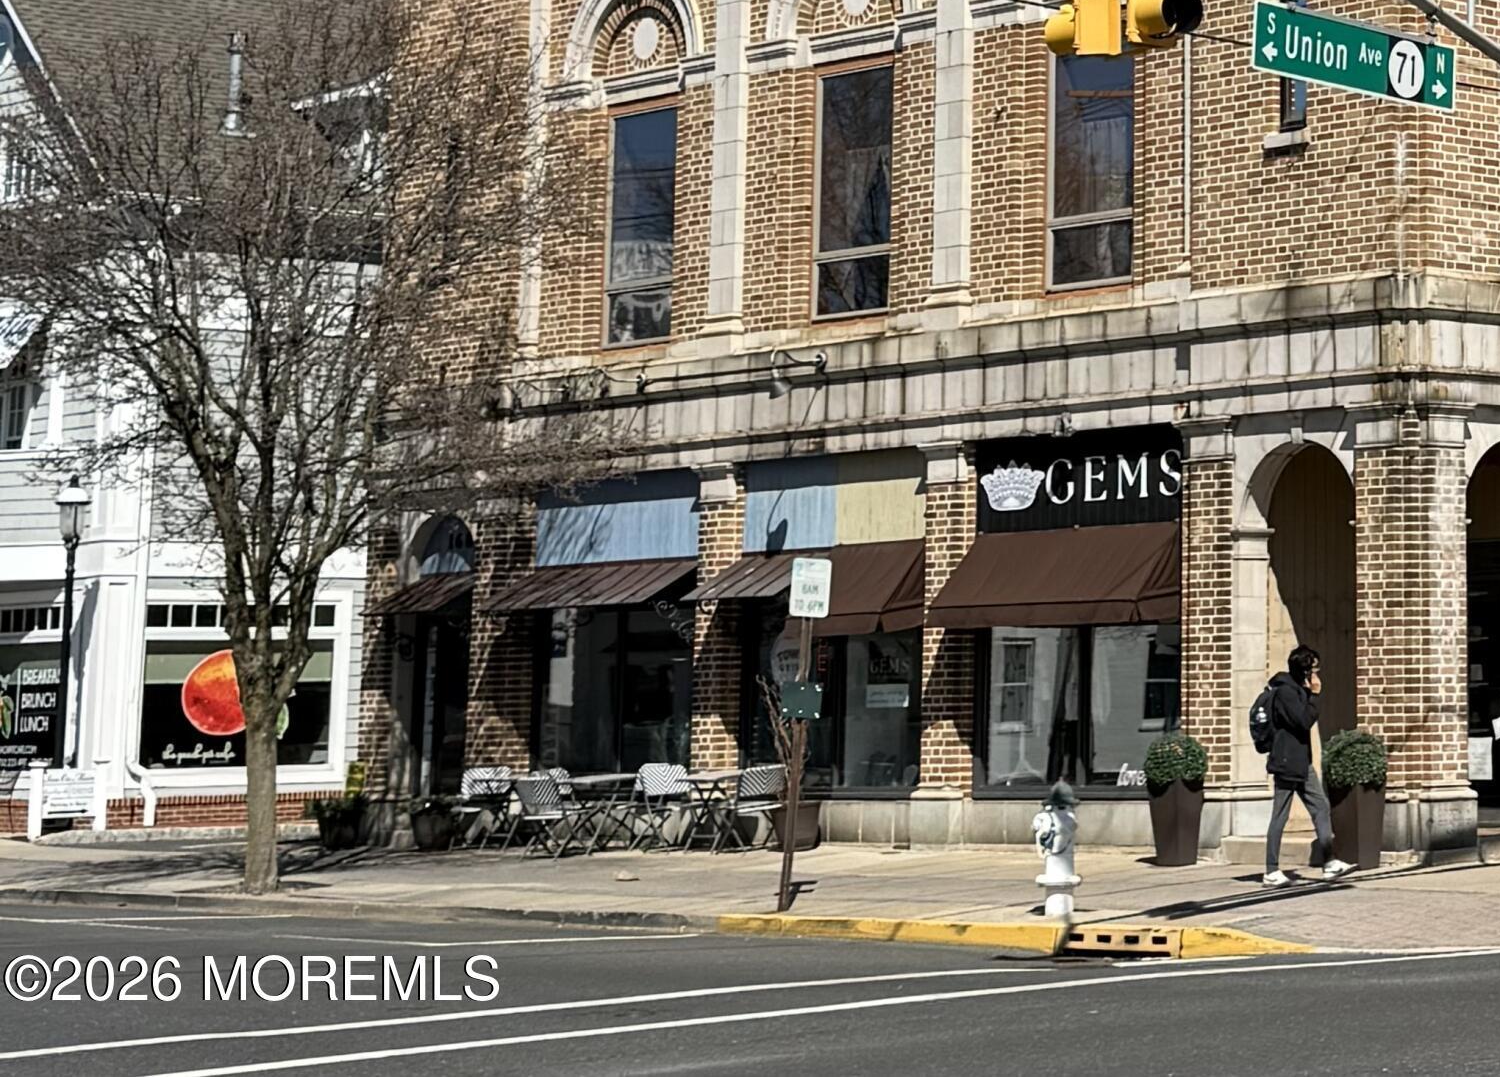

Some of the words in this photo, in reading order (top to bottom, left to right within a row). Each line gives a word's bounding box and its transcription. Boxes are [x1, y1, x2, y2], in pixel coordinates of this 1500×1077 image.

[1267, 12, 1276, 35] S
[1285, 24, 1348, 70] Union
[1359, 42, 1382, 66] Ave
[1396, 52, 1415, 87] 71
[1436, 53, 1445, 74] N
[1045, 449, 1181, 505] GEMS
[870, 657, 909, 673] GEMS
[22, 668, 61, 685] BREAKFA
[21, 692, 56, 709] BRUNCH
[20, 716, 49, 733] LUNCH
